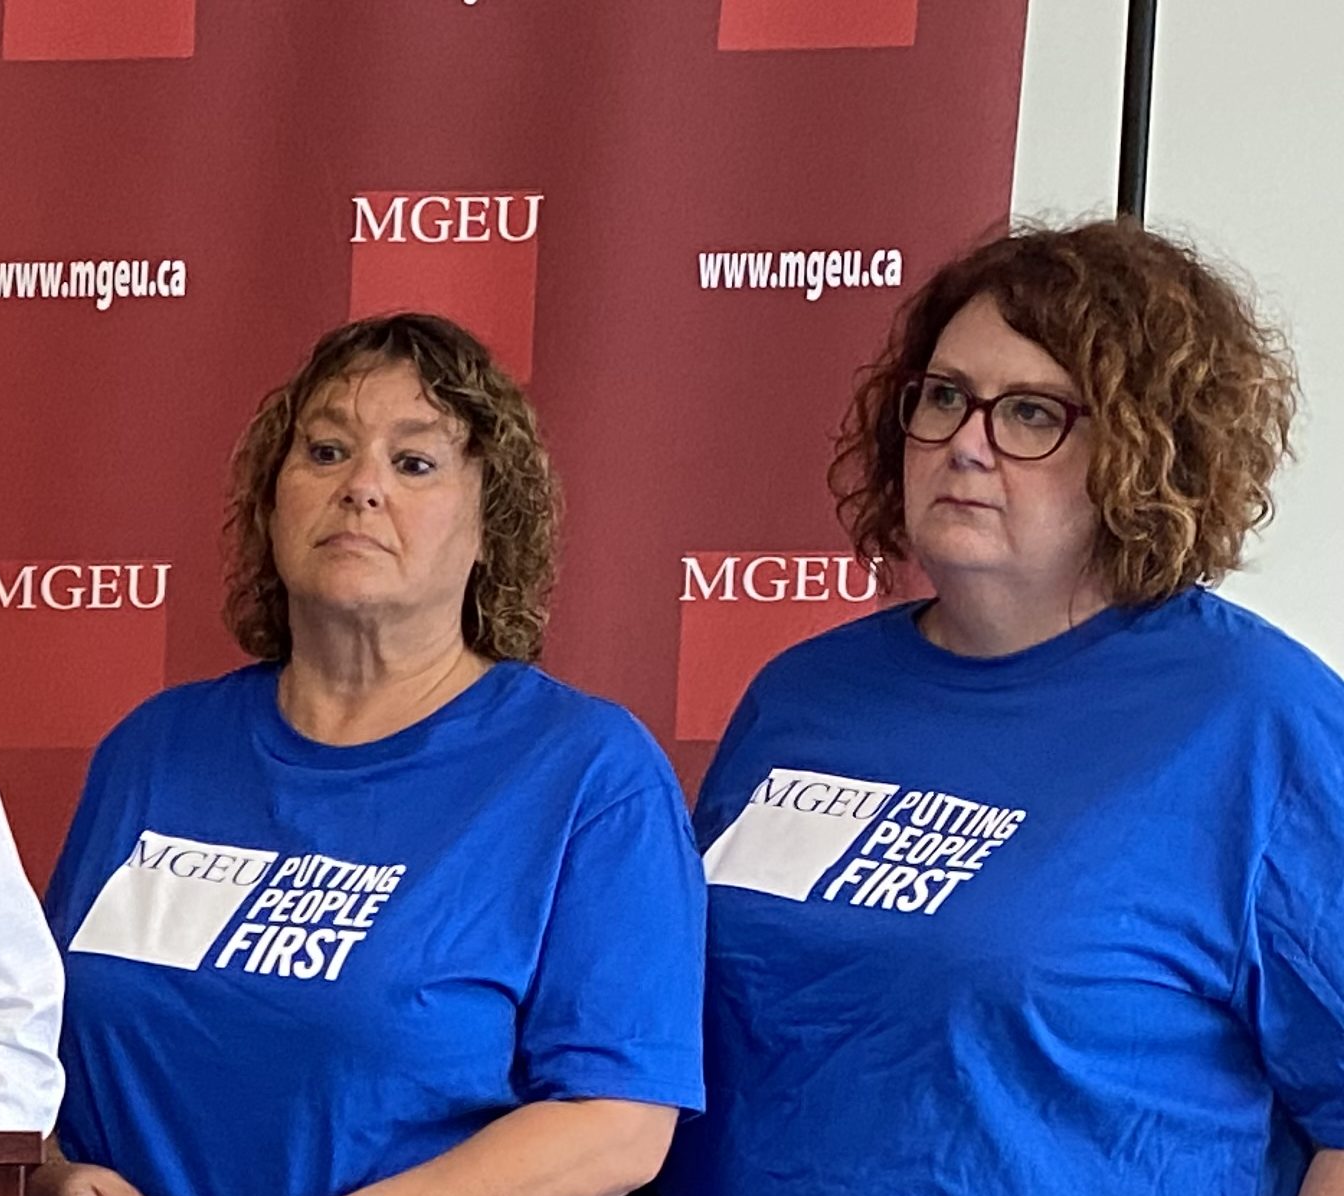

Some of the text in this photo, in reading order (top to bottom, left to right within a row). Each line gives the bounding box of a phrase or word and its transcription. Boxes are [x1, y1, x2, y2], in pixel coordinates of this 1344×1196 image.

[350, 195, 544, 243] MGEU
[698, 249, 903, 302] www.mgeu.ca
[678, 556, 885, 602] MGEU
[750, 777, 893, 820] MGEU
[886, 791, 1027, 840] PUTTING
[126, 839, 273, 887] MGEU
[860, 820, 1004, 871] PEOPLE
[268, 854, 408, 895] PUTTING
[822, 858, 974, 916] FIRST
[245, 888, 391, 929] PEOPLE
[214, 922, 368, 982] FIRST
